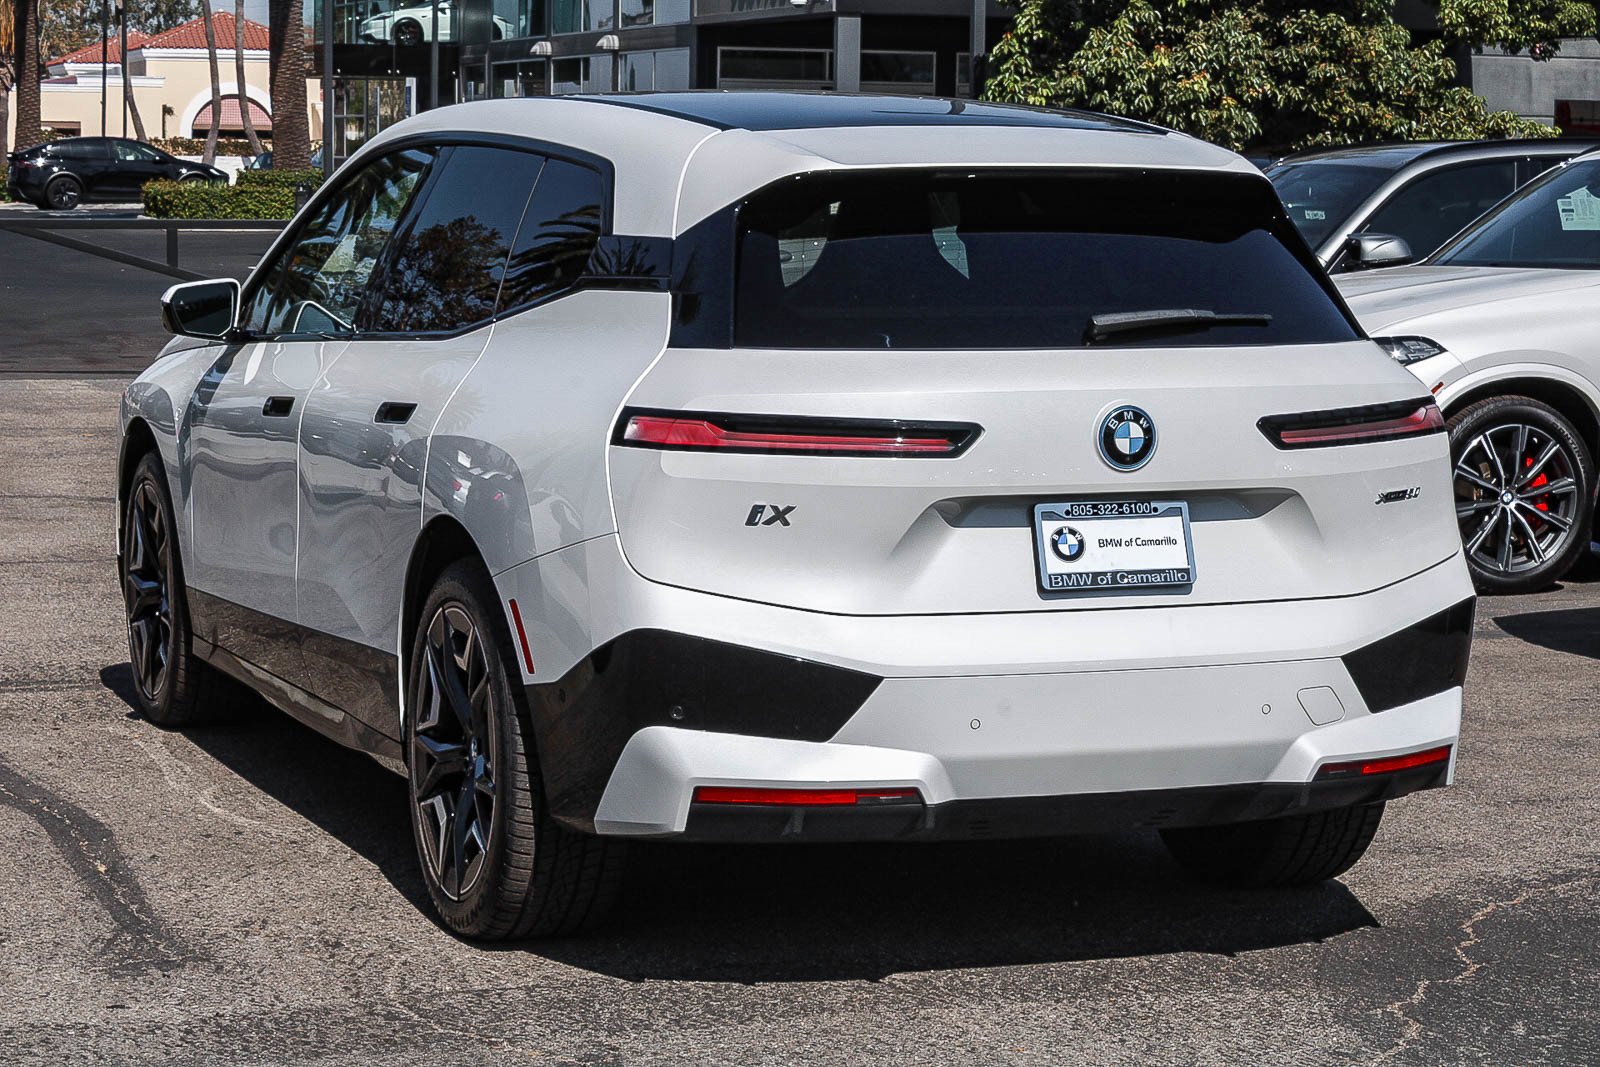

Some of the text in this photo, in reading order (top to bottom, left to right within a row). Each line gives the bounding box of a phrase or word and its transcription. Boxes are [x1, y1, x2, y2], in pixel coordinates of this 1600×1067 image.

[1107, 410, 1150, 430] BMW
[1071, 502, 1150, 517] 805-322-6100
[1052, 527, 1083, 541] BMW
[1097, 536, 1178, 549] BMW of Camarillo
[1051, 569, 1188, 588] BMW of Camarillo
